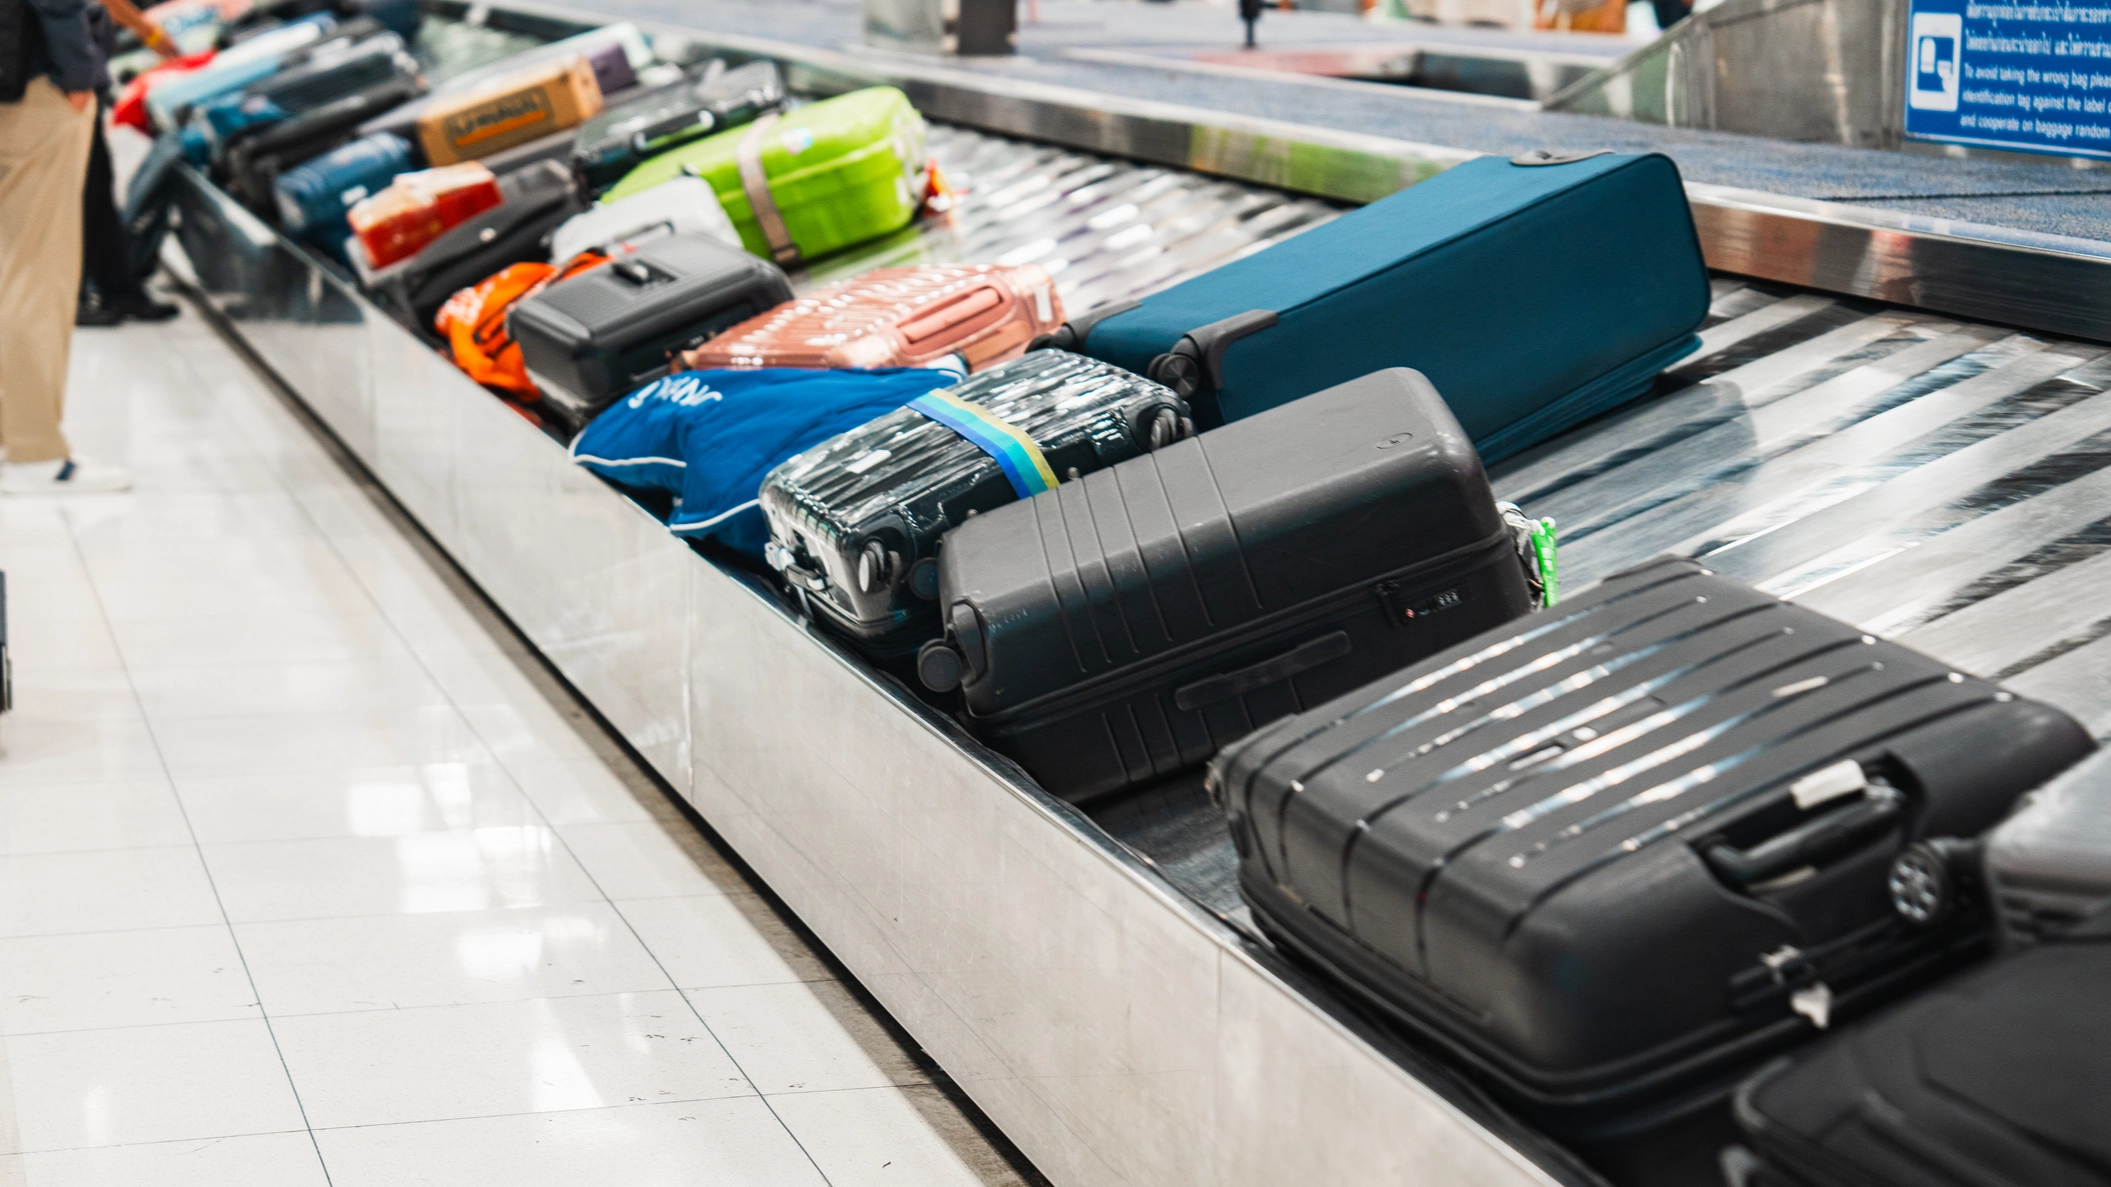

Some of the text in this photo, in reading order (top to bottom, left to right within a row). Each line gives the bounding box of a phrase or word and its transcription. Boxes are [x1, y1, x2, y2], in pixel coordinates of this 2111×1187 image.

[1964, 62, 1974, 79] To
[1975, 63, 1998, 80] avoid
[2000, 64, 2025, 86] taking
[2027, 66, 2040, 83] the
[2042, 70, 2069, 89] wrong
[2071, 69, 2088, 90] bag
[1962, 87, 2015, 106] identification
[2017, 92, 2031, 112] tag
[2033, 93, 2065, 113] against
[2067, 95, 2081, 112] the
[2083, 96, 2106, 114] label
[1960, 112, 2111, 140] and cooperate on baggage random
